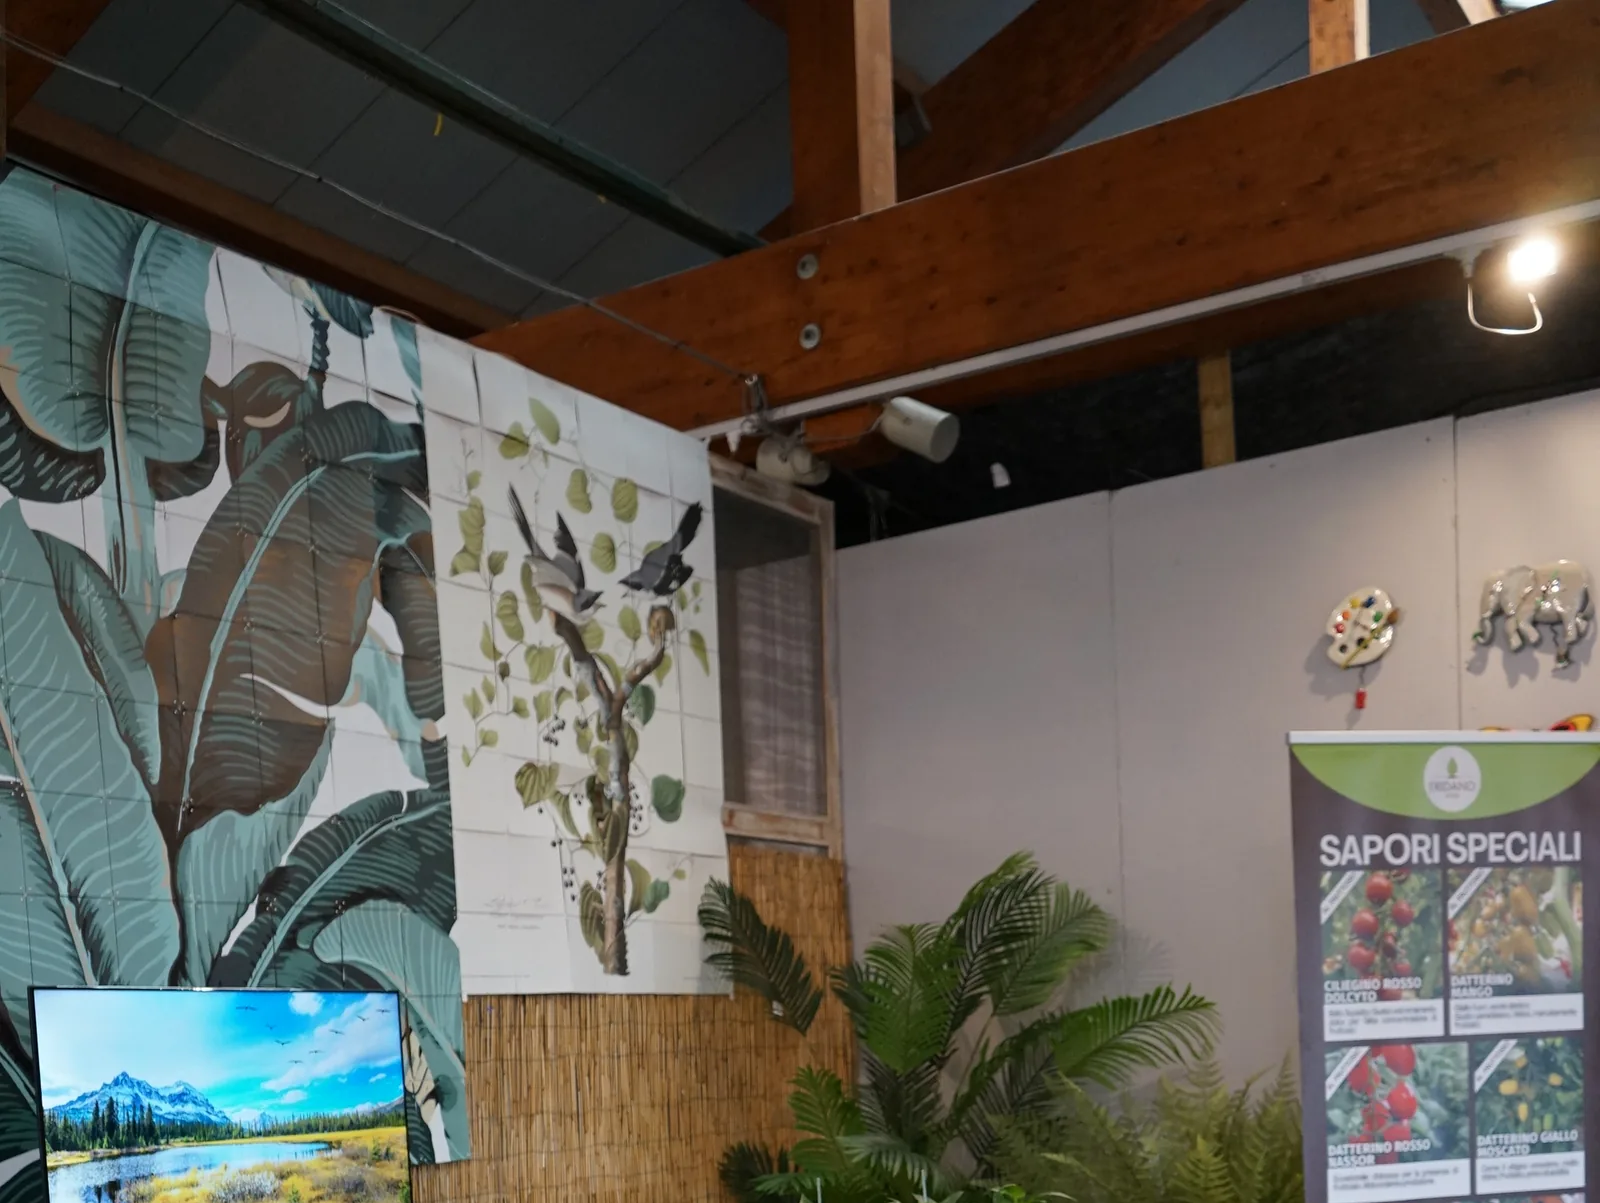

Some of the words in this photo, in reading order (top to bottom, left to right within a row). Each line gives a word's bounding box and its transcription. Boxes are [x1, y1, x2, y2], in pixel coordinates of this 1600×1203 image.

[1319, 833, 1441, 867] SAPORI
[1446, 831, 1582, 864] SPECIALI
[1323, 977, 1381, 993] CILIEGINO
[1382, 976, 1422, 990] ROSSO
[1450, 973, 1514, 987] DATTERINO
[1450, 985, 1493, 999] MANGO
[1477, 1132, 1538, 1147] DATTERINO
[1540, 1129, 1578, 1144] GIALLO
[1328, 1140, 1393, 1157] DATTERINO
[1394, 1138, 1432, 1153] ROSSO
[1477, 1144, 1531, 1159] MOSCATO
